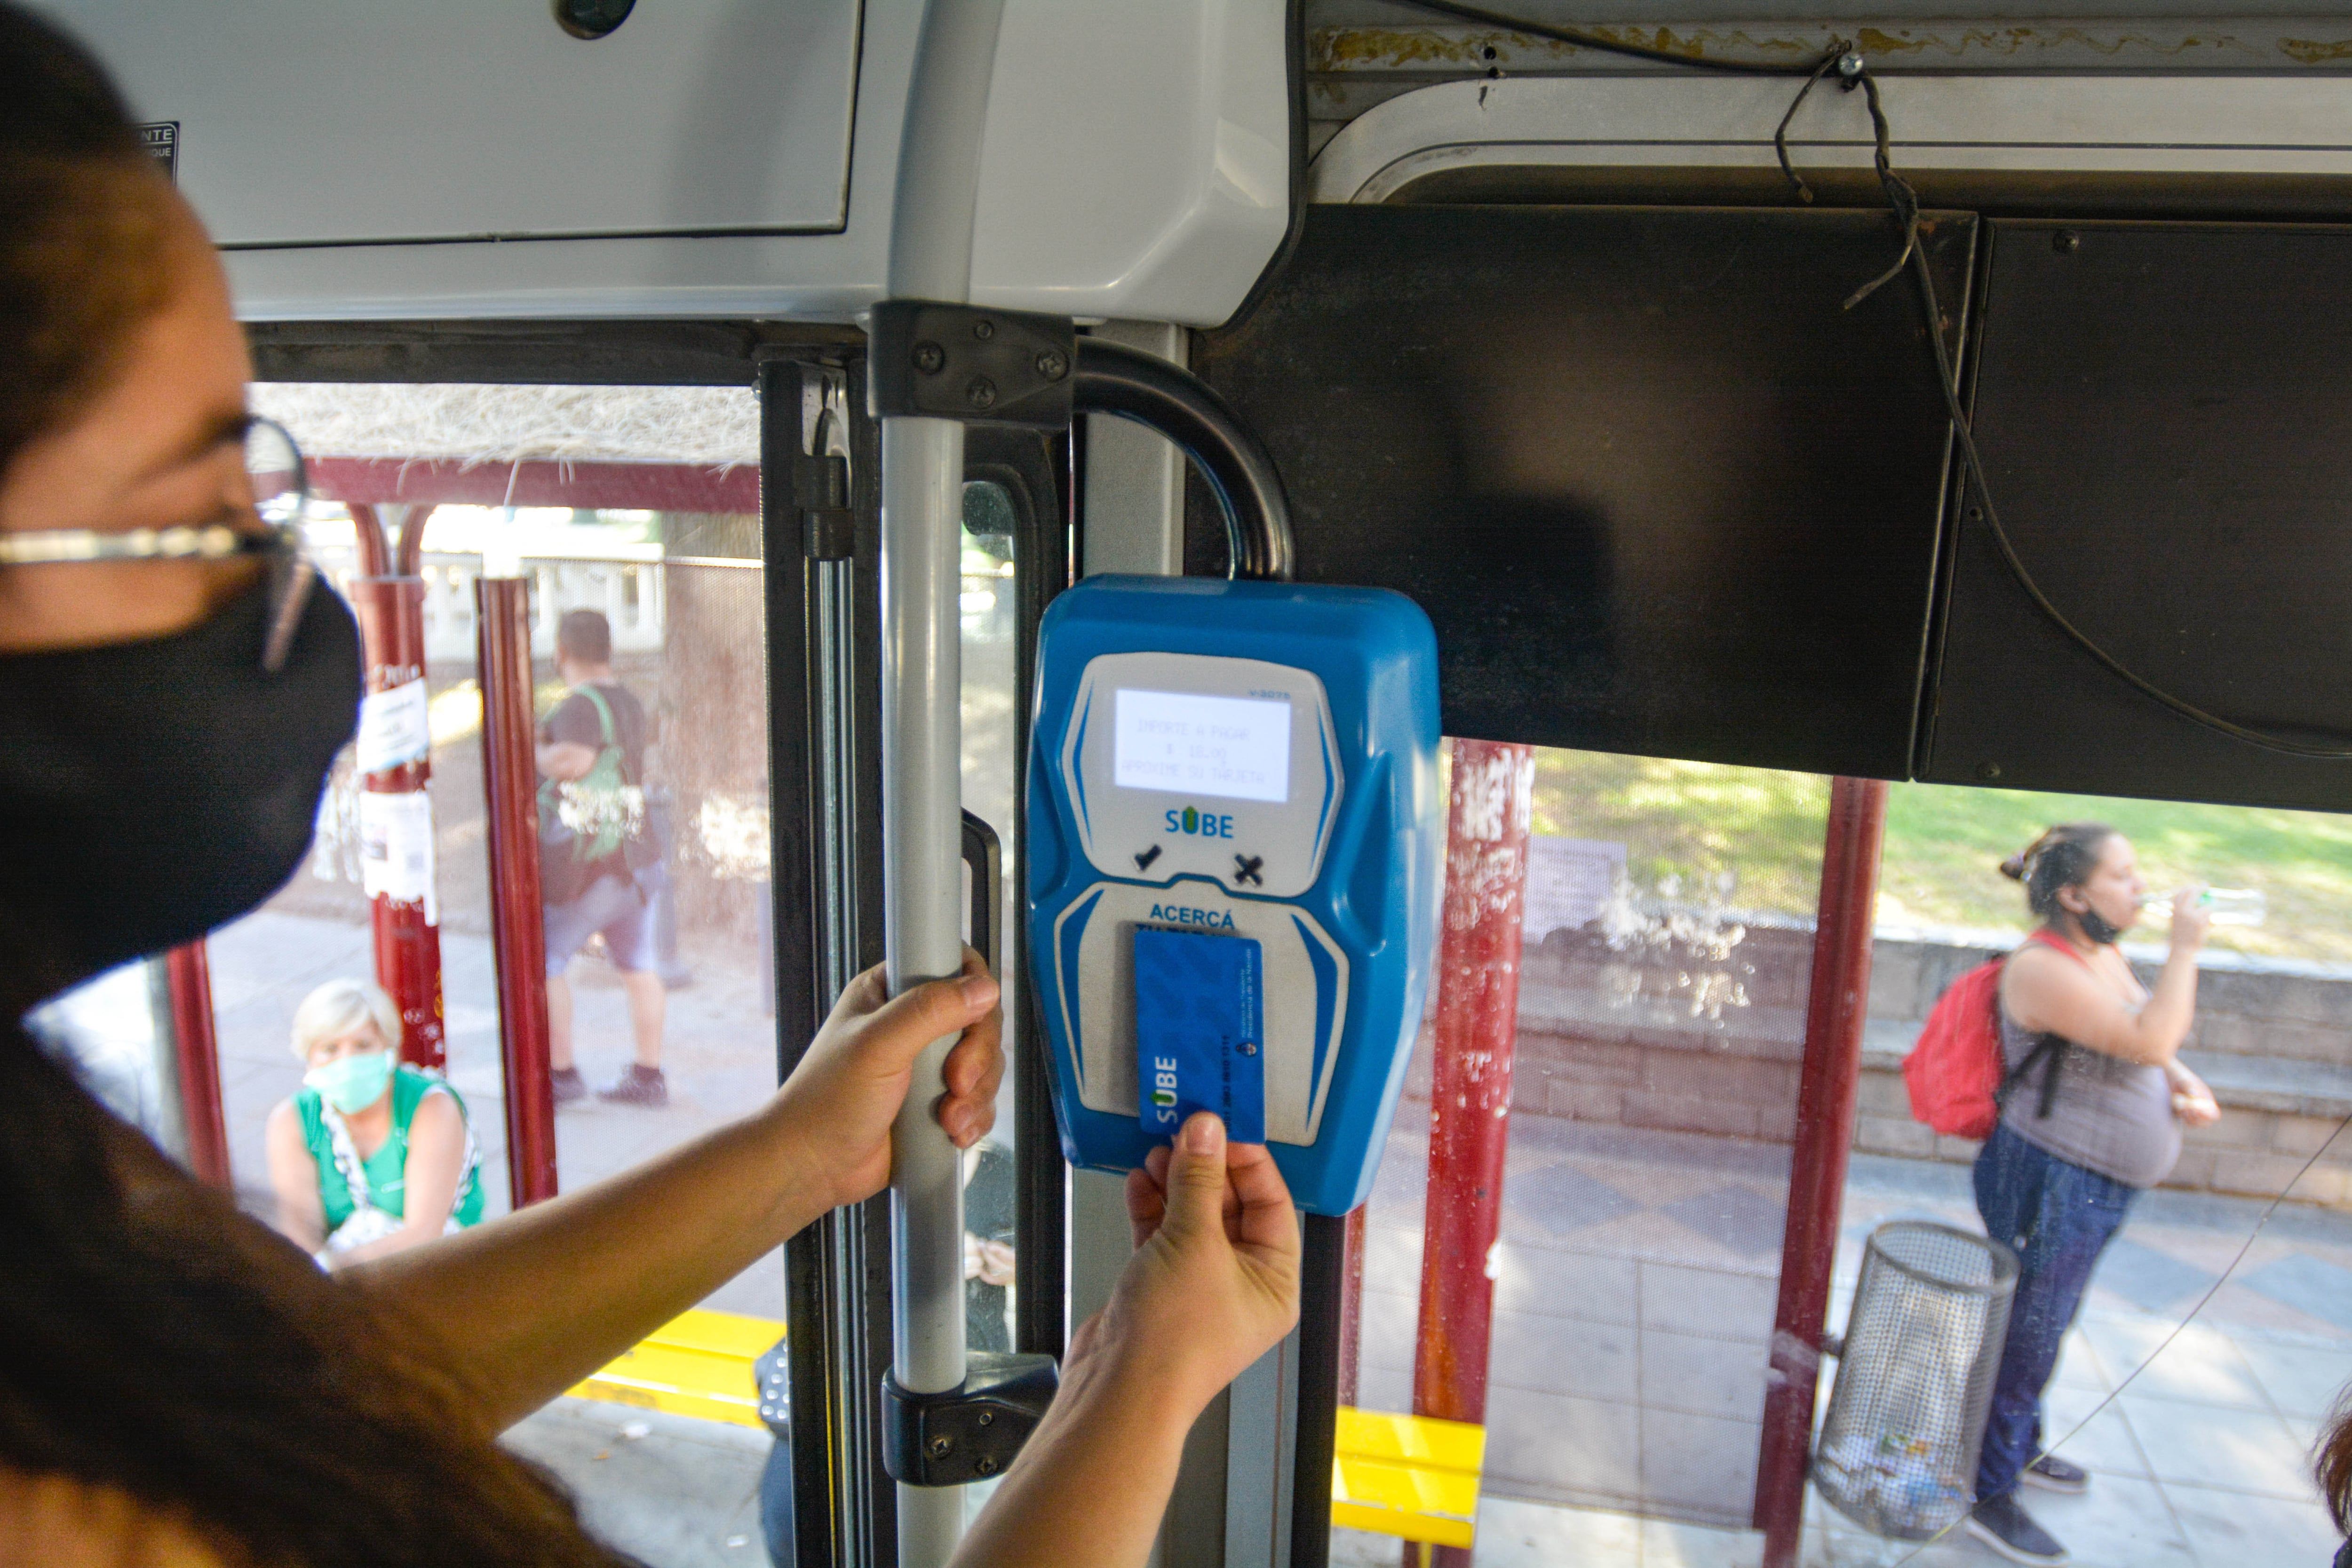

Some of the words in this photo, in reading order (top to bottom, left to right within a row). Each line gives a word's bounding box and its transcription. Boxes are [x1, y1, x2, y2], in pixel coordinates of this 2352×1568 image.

[1165, 806, 1234, 839] SUBE
[1150, 904, 1236, 930] ACERCÁ
[1150, 1056, 1177, 1123] SUBE
